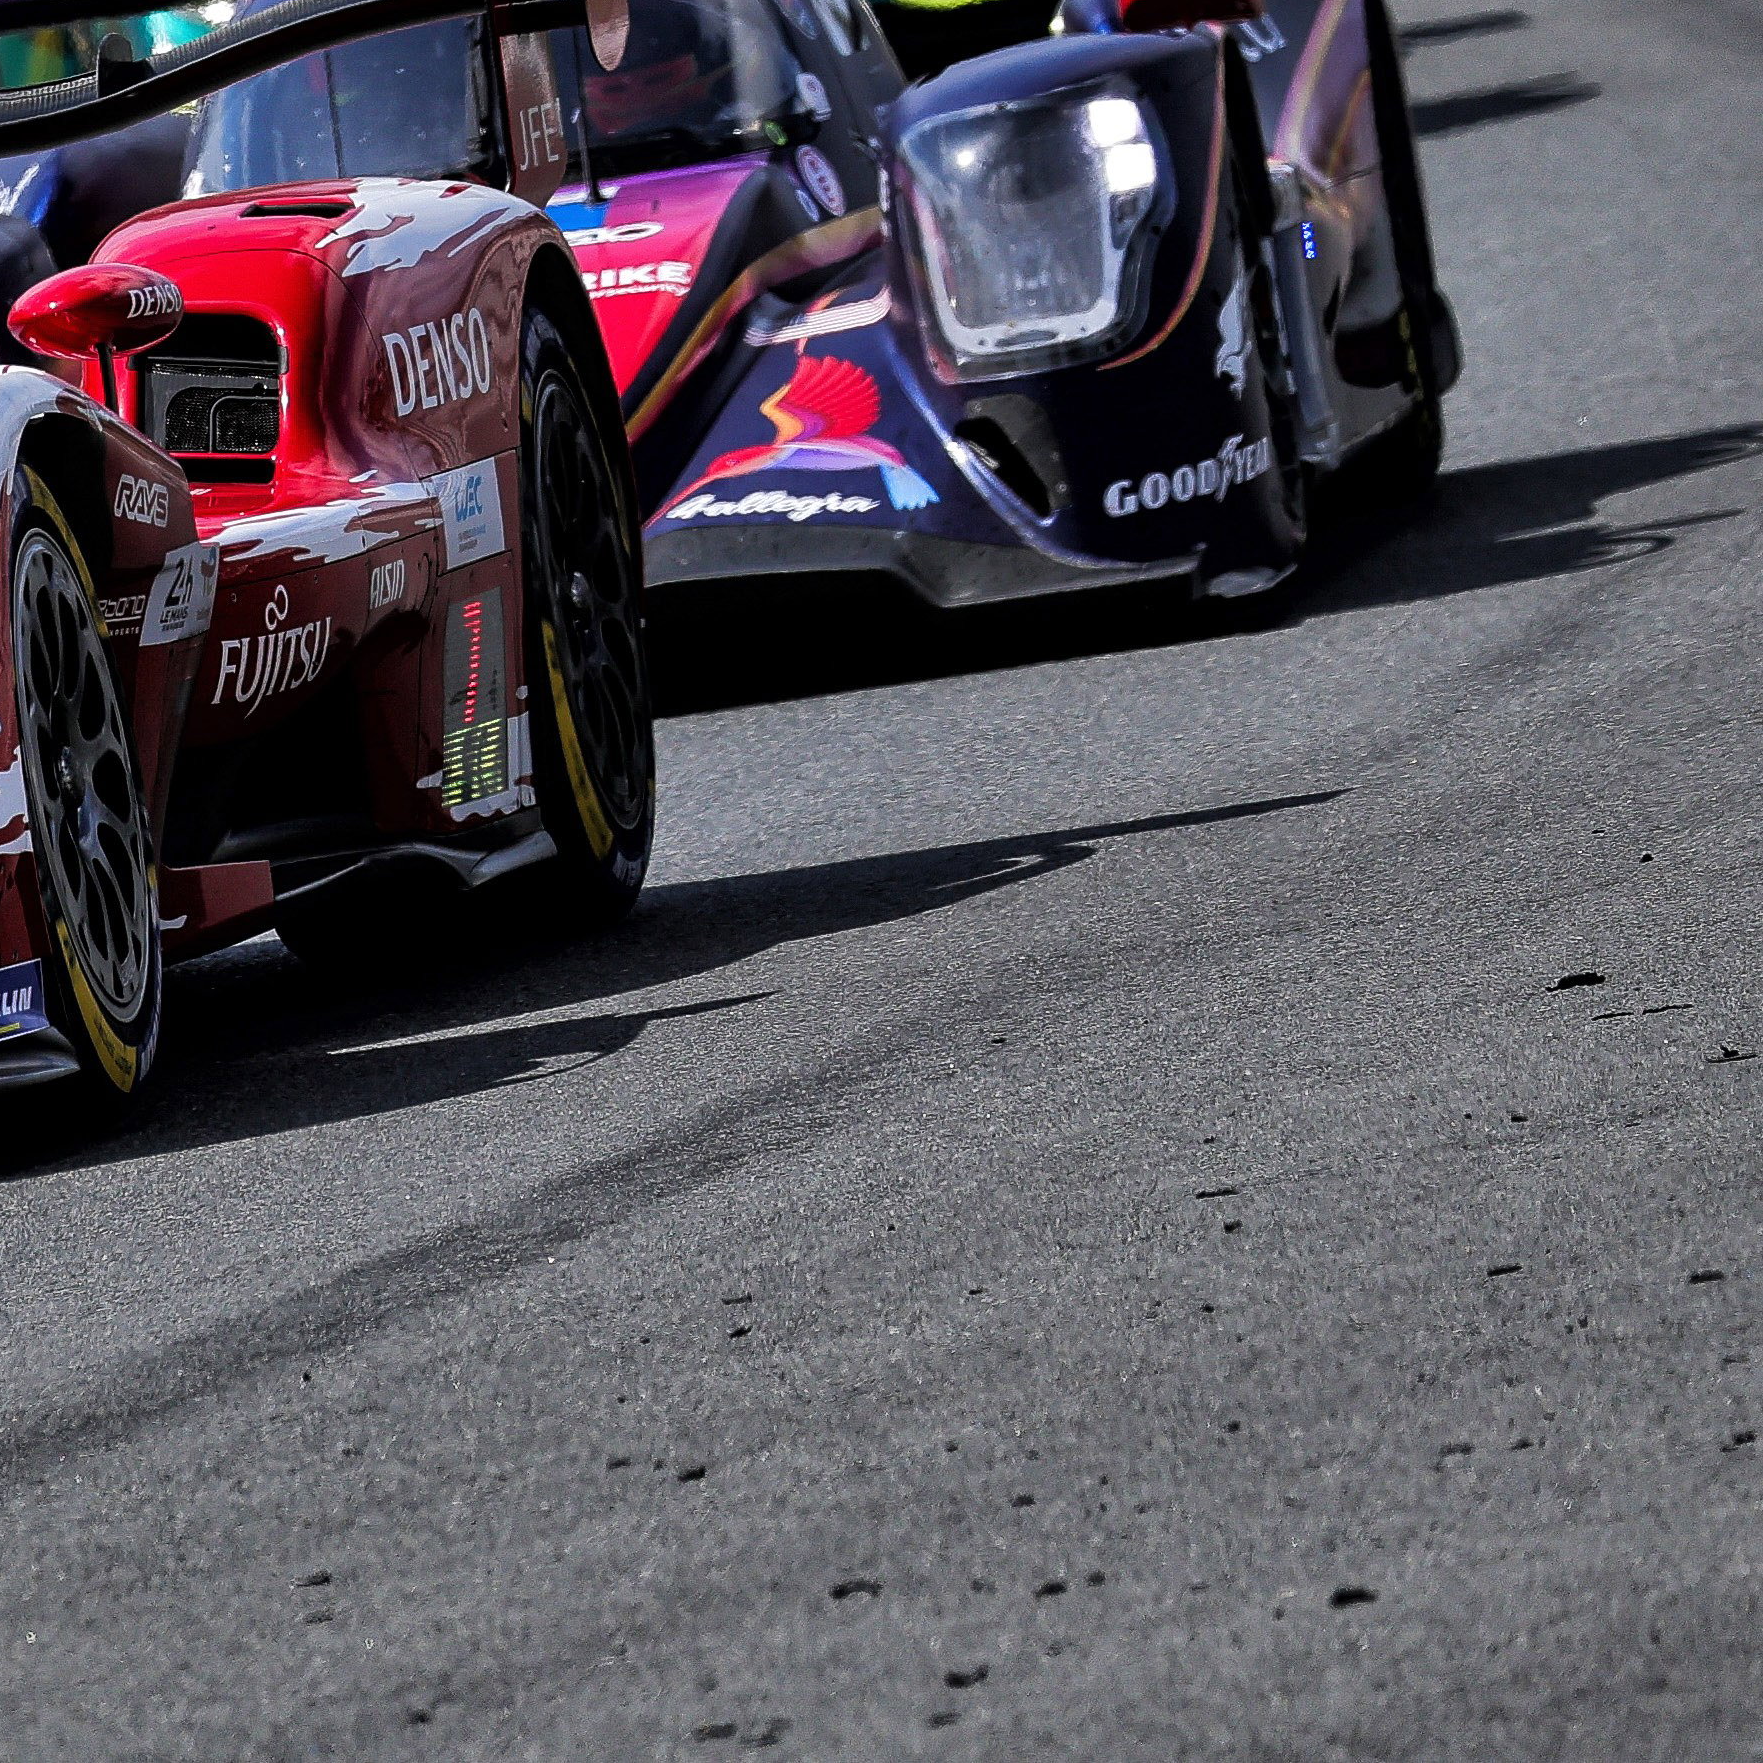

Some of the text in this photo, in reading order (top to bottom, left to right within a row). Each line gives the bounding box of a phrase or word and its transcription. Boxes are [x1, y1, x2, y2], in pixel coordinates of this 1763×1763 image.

[382, 307, 490, 417] DENSO
[114, 473, 168, 528] RAYS
[164, 553, 194, 608] 24h
[370, 559, 404, 609] AISIN
[109, 626, 140, 637] XPERTS
[210, 617, 332, 719] FUJITSU
